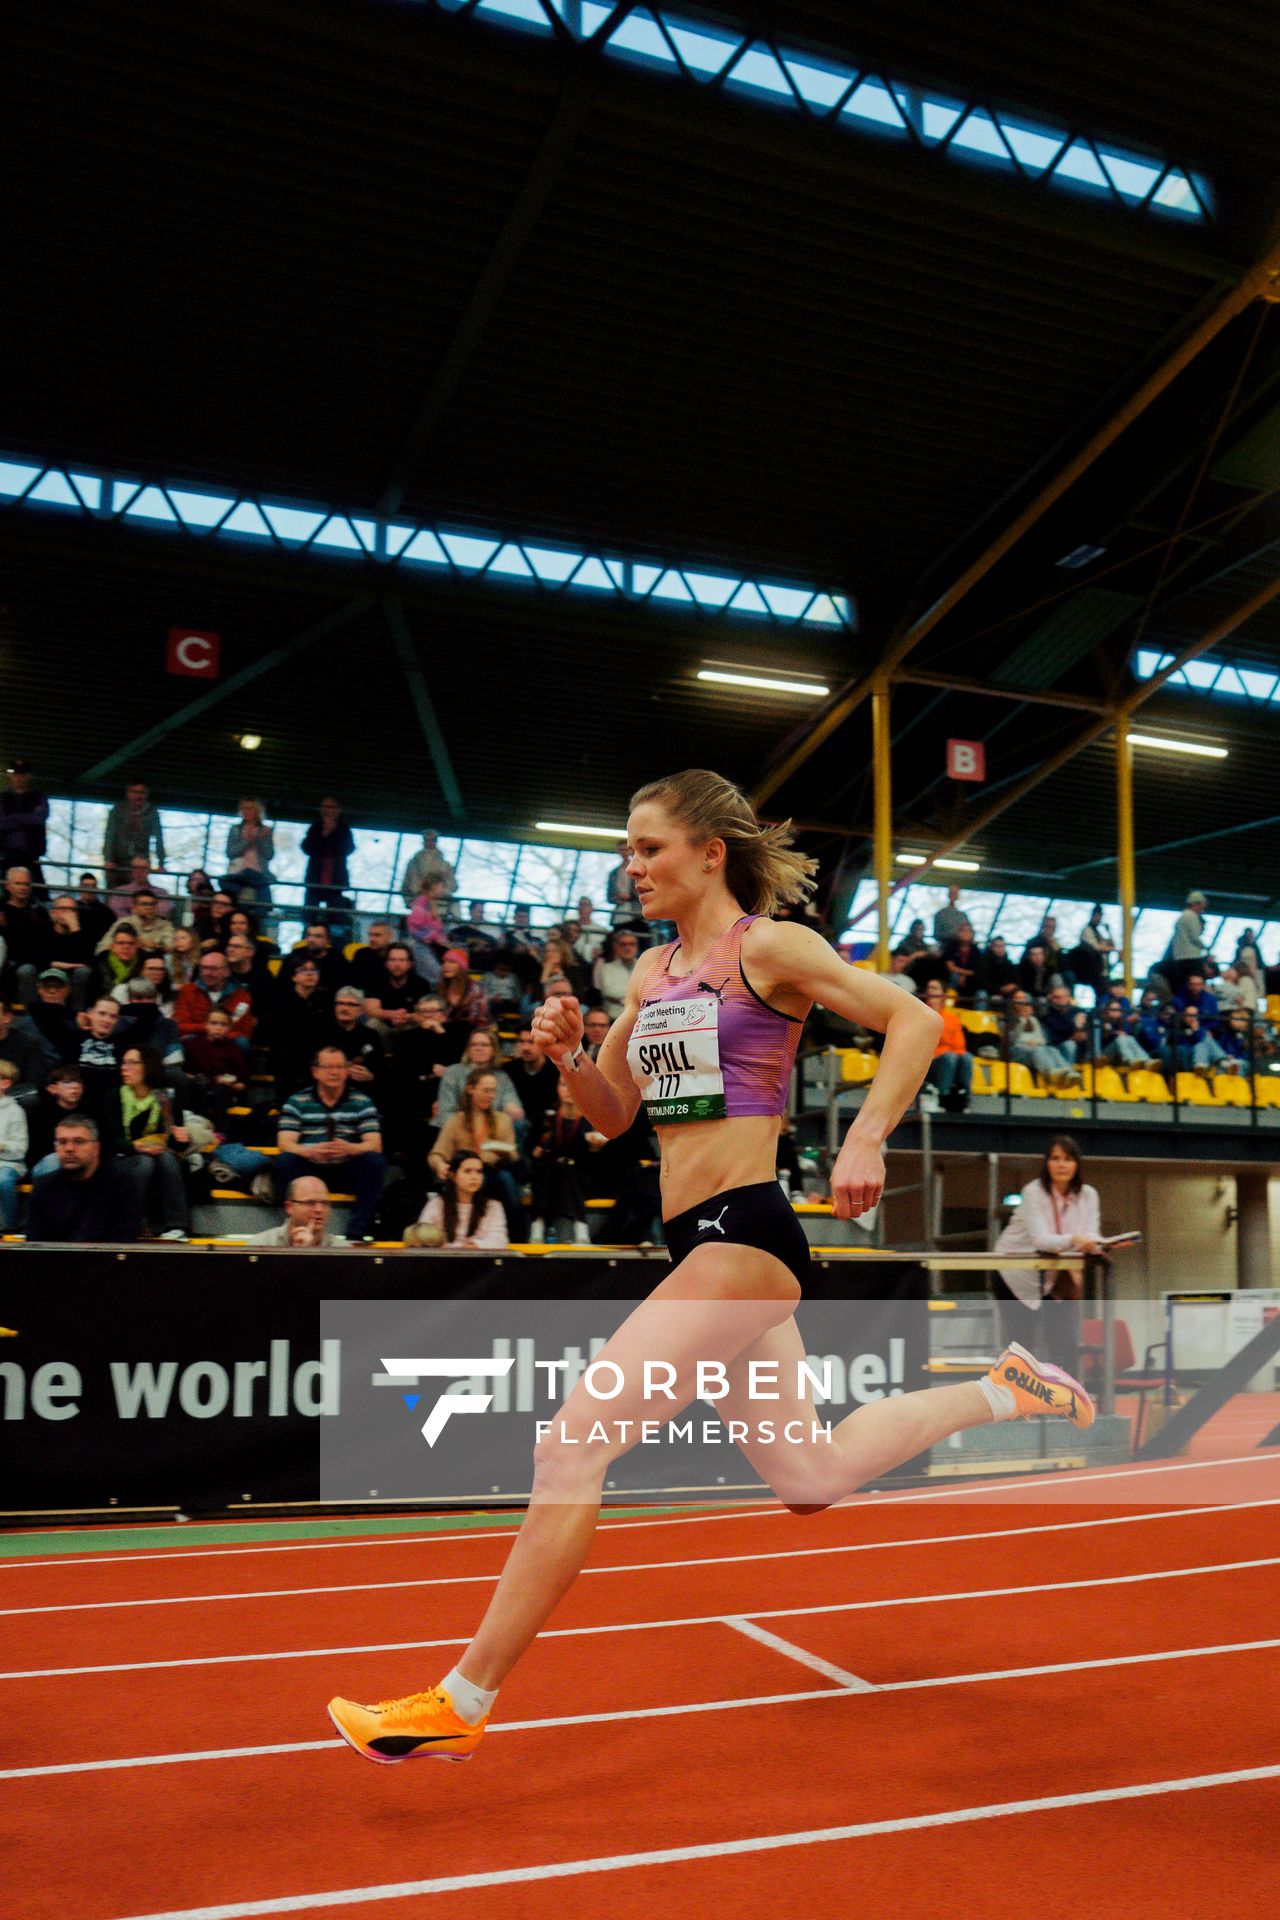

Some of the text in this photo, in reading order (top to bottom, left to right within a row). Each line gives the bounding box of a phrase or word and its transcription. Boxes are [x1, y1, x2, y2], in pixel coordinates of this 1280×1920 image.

[176, 636, 212, 670] C
[953, 744, 977, 775] B
[641, 1019, 668, 1032] Dortmund
[656, 1005, 686, 1017] Meeting
[639, 1040, 696, 1076] SPILL
[658, 1073, 681, 1098] 177
[676, 1103, 689, 1115] 26
[109, 1338, 342, 1419] world
[1004, 1366, 1056, 1407] NITRO
